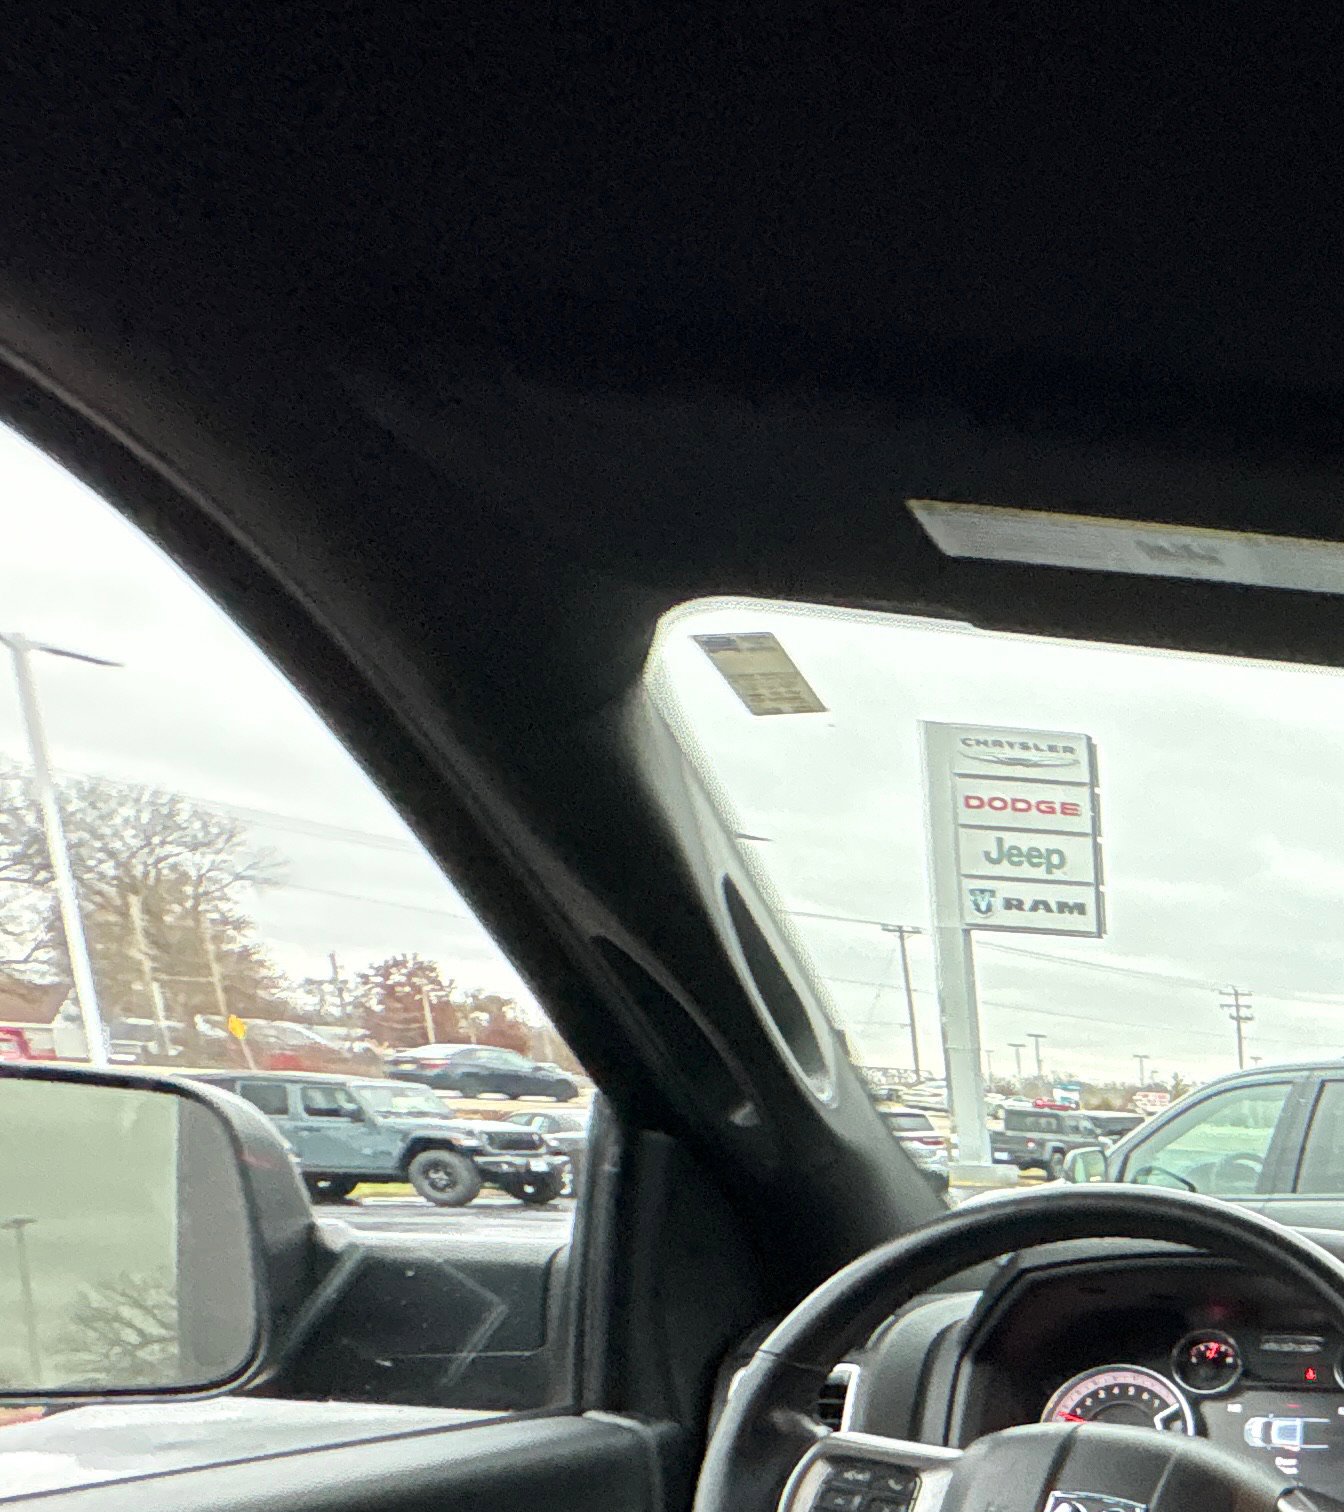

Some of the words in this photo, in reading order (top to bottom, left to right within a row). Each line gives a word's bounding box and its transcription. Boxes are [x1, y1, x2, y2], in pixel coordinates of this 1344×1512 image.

[960, 738, 1077, 754] CHRYSLER
[963, 795, 1081, 816] DODGE
[983, 837, 1067, 874] Jeep
[1002, 897, 1087, 915] RAM
